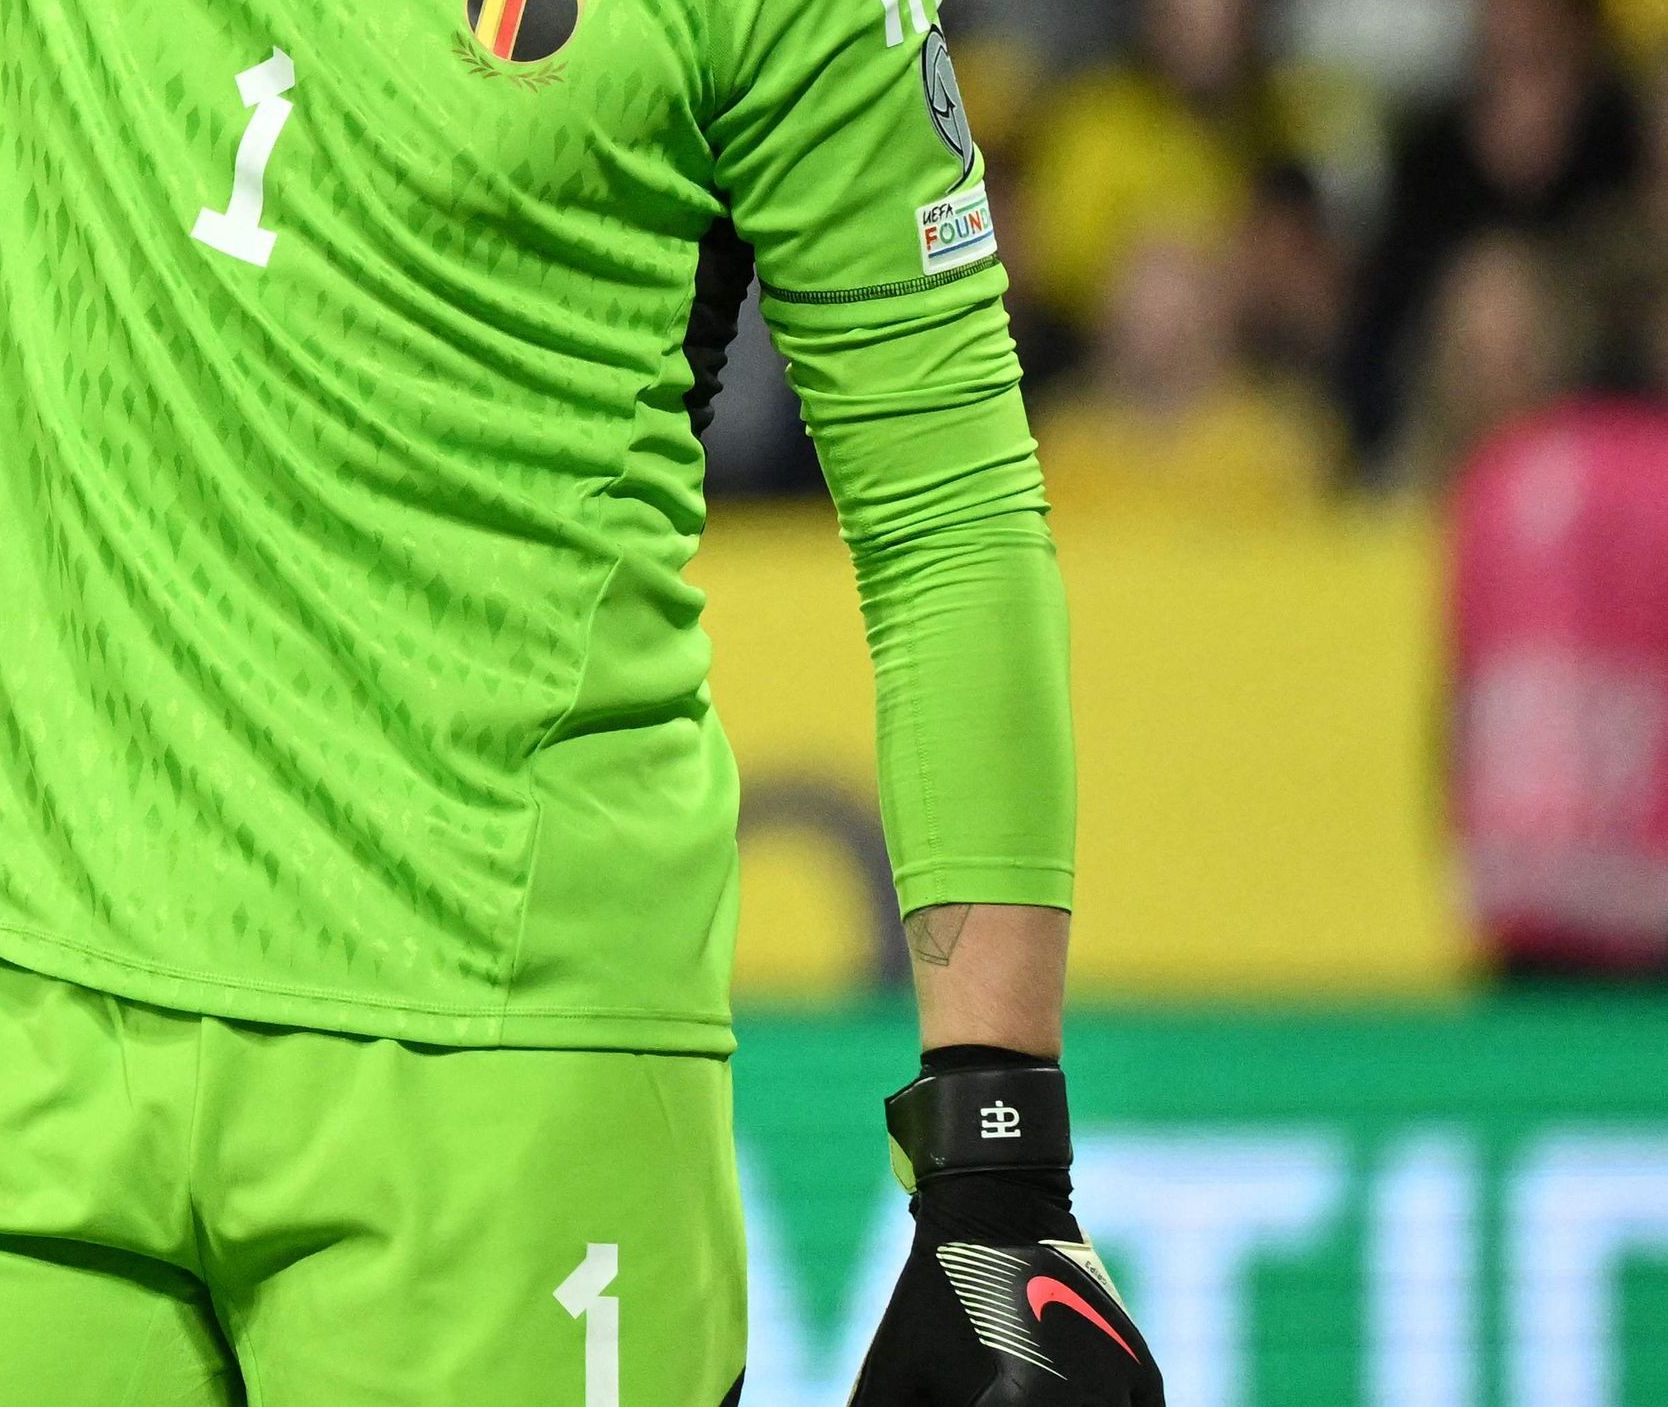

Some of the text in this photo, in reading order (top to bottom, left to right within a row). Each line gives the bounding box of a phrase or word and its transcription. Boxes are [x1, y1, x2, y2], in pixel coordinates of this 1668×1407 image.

[191, 46, 296, 268] 1
[923, 203, 954, 225] UEFA
[552, 1243, 620, 1407] 1
